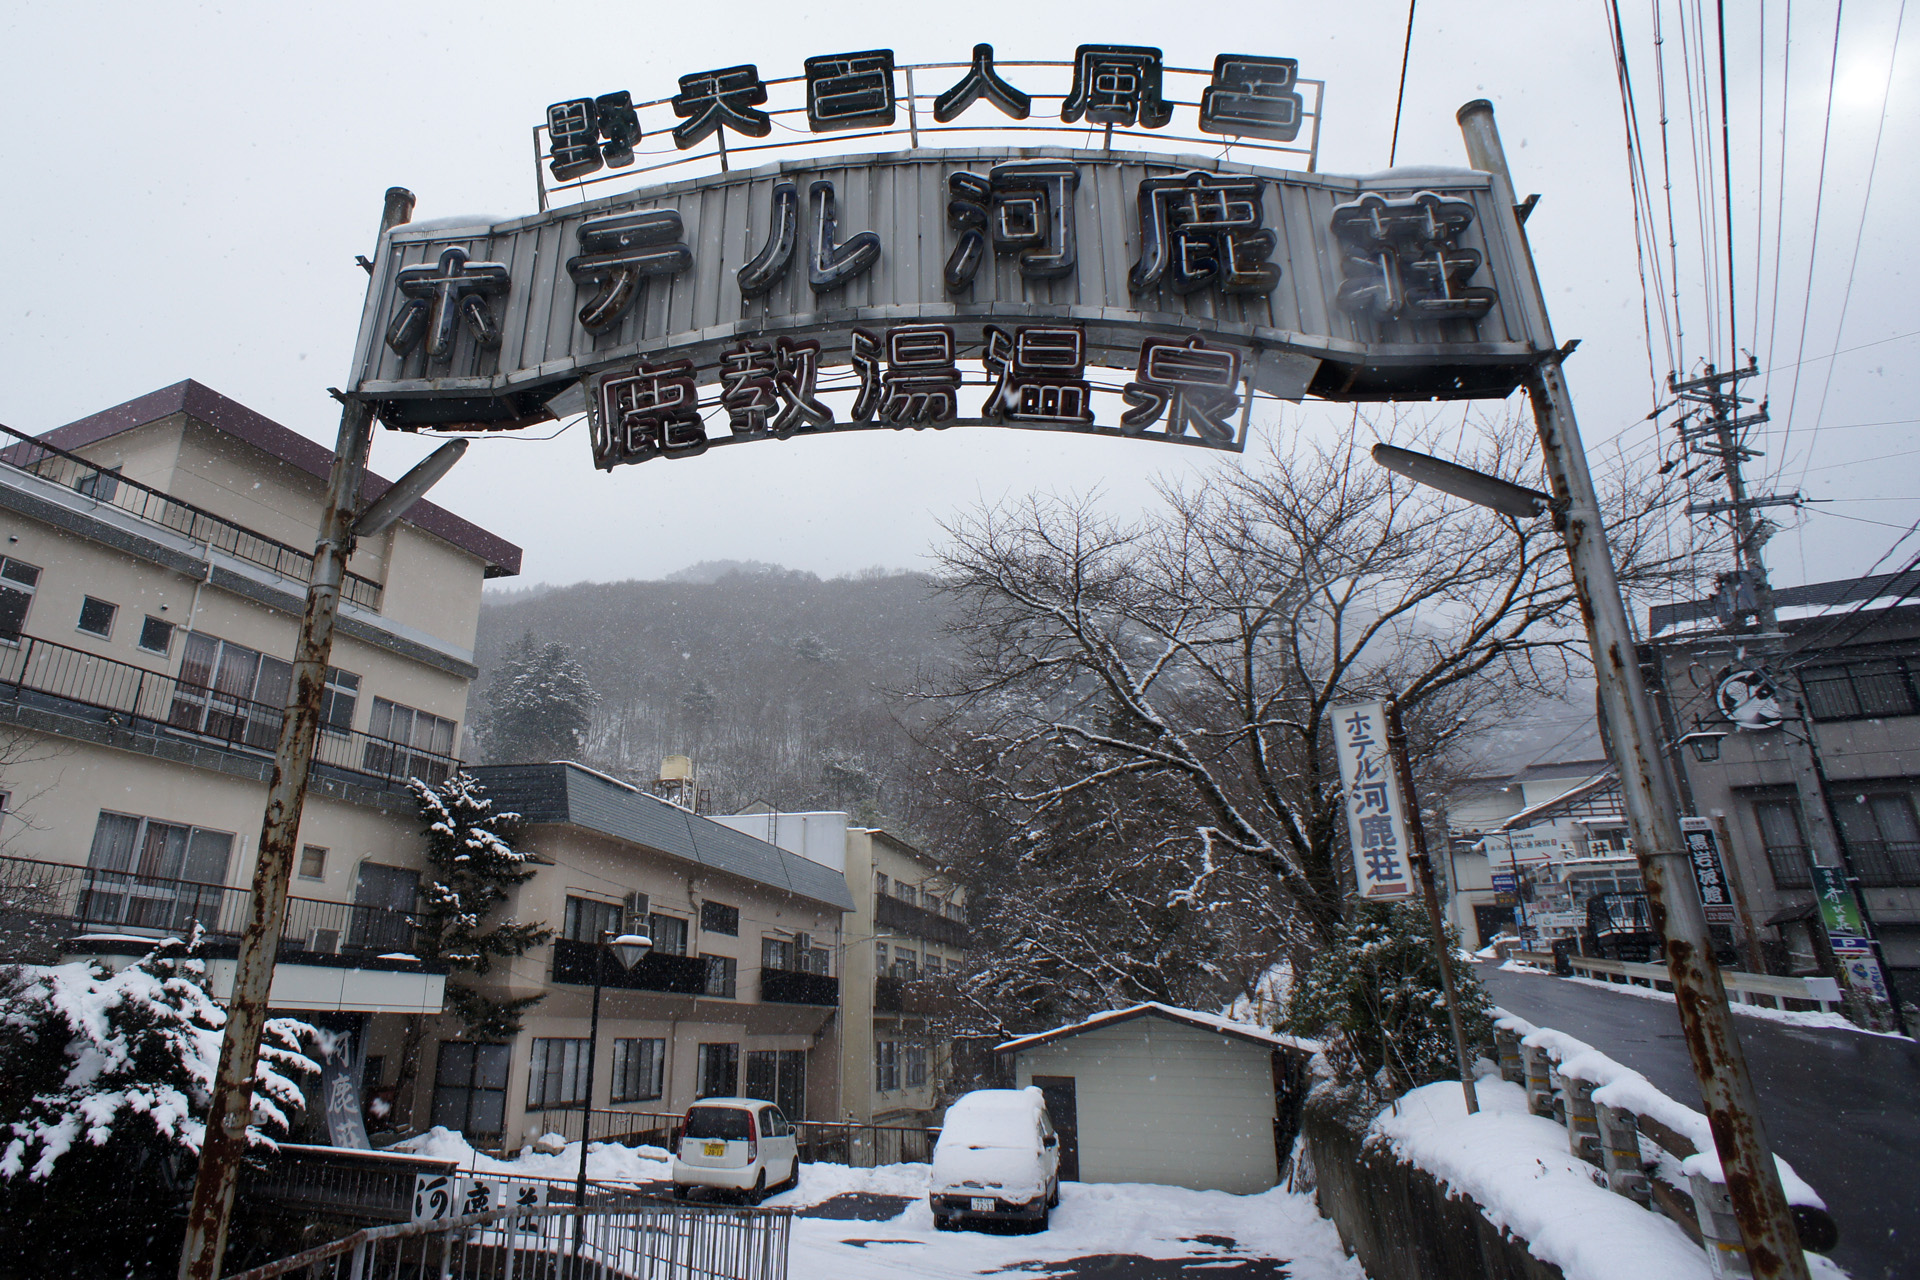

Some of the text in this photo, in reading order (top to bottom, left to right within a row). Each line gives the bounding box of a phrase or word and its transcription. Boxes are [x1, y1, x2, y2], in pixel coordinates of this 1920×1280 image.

[546, 44, 1303, 182] 野天百人風呂
[385, 158, 1497, 364] ホテル河鹿荘
[592, 322, 1243, 474] 鹿教湯温泉
[1345, 711, 1403, 882] ホテル河鹿荘
[1688, 834, 1723, 903] 黒岩旅館
[1842, 939, 1856, 947] P
